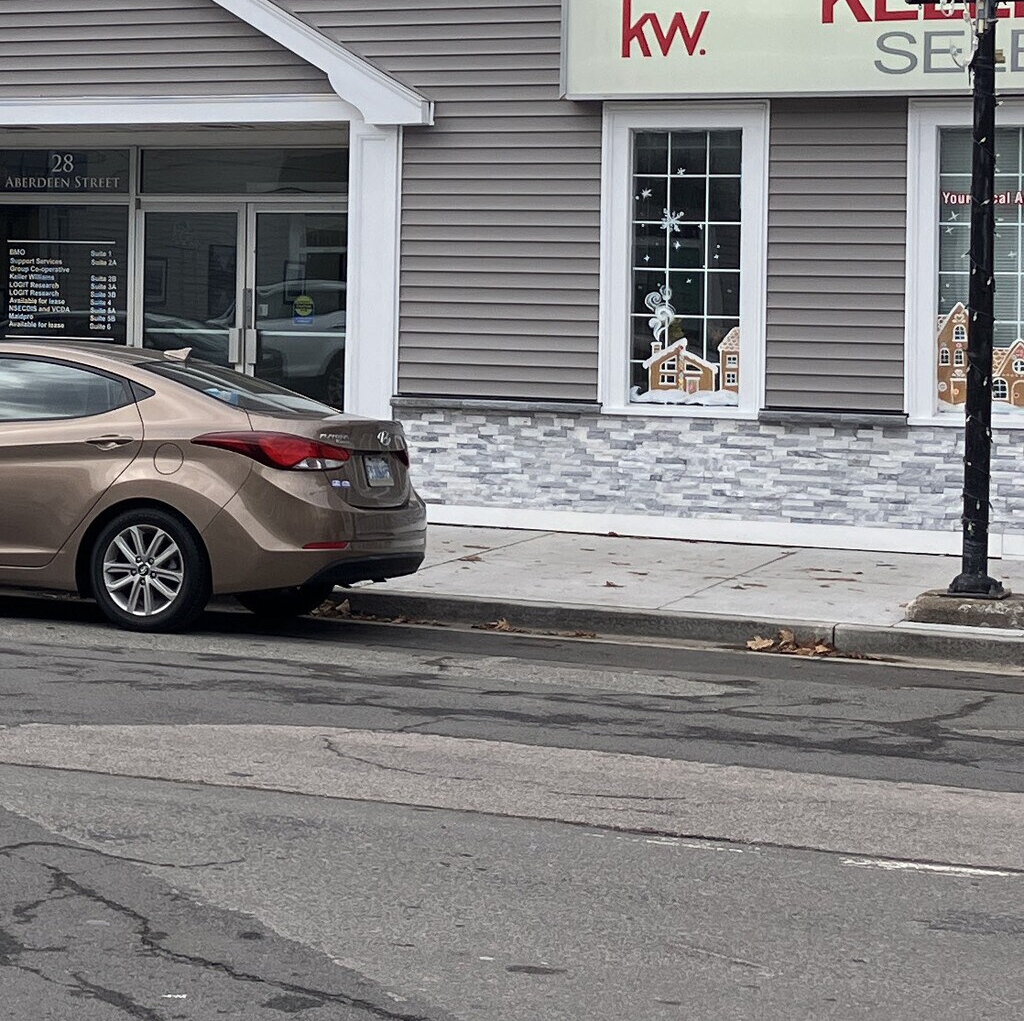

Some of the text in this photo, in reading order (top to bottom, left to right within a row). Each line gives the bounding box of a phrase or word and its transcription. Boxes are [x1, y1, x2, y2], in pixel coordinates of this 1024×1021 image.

[51, 153, 74, 173] 28
[5, 176, 120, 188] ABERDEEN STREET
[9, 248, 26, 256] BMO
[10, 257, 35, 265] Support
[35, 257, 63, 265] Services
[9, 265, 70, 273] Group Co-operative
[28, 273, 55, 281] Williams
[30, 281, 60, 289] Research
[30, 289, 60, 297] Research
[48, 297, 65, 305] lease
[48, 321, 65, 329] lease
